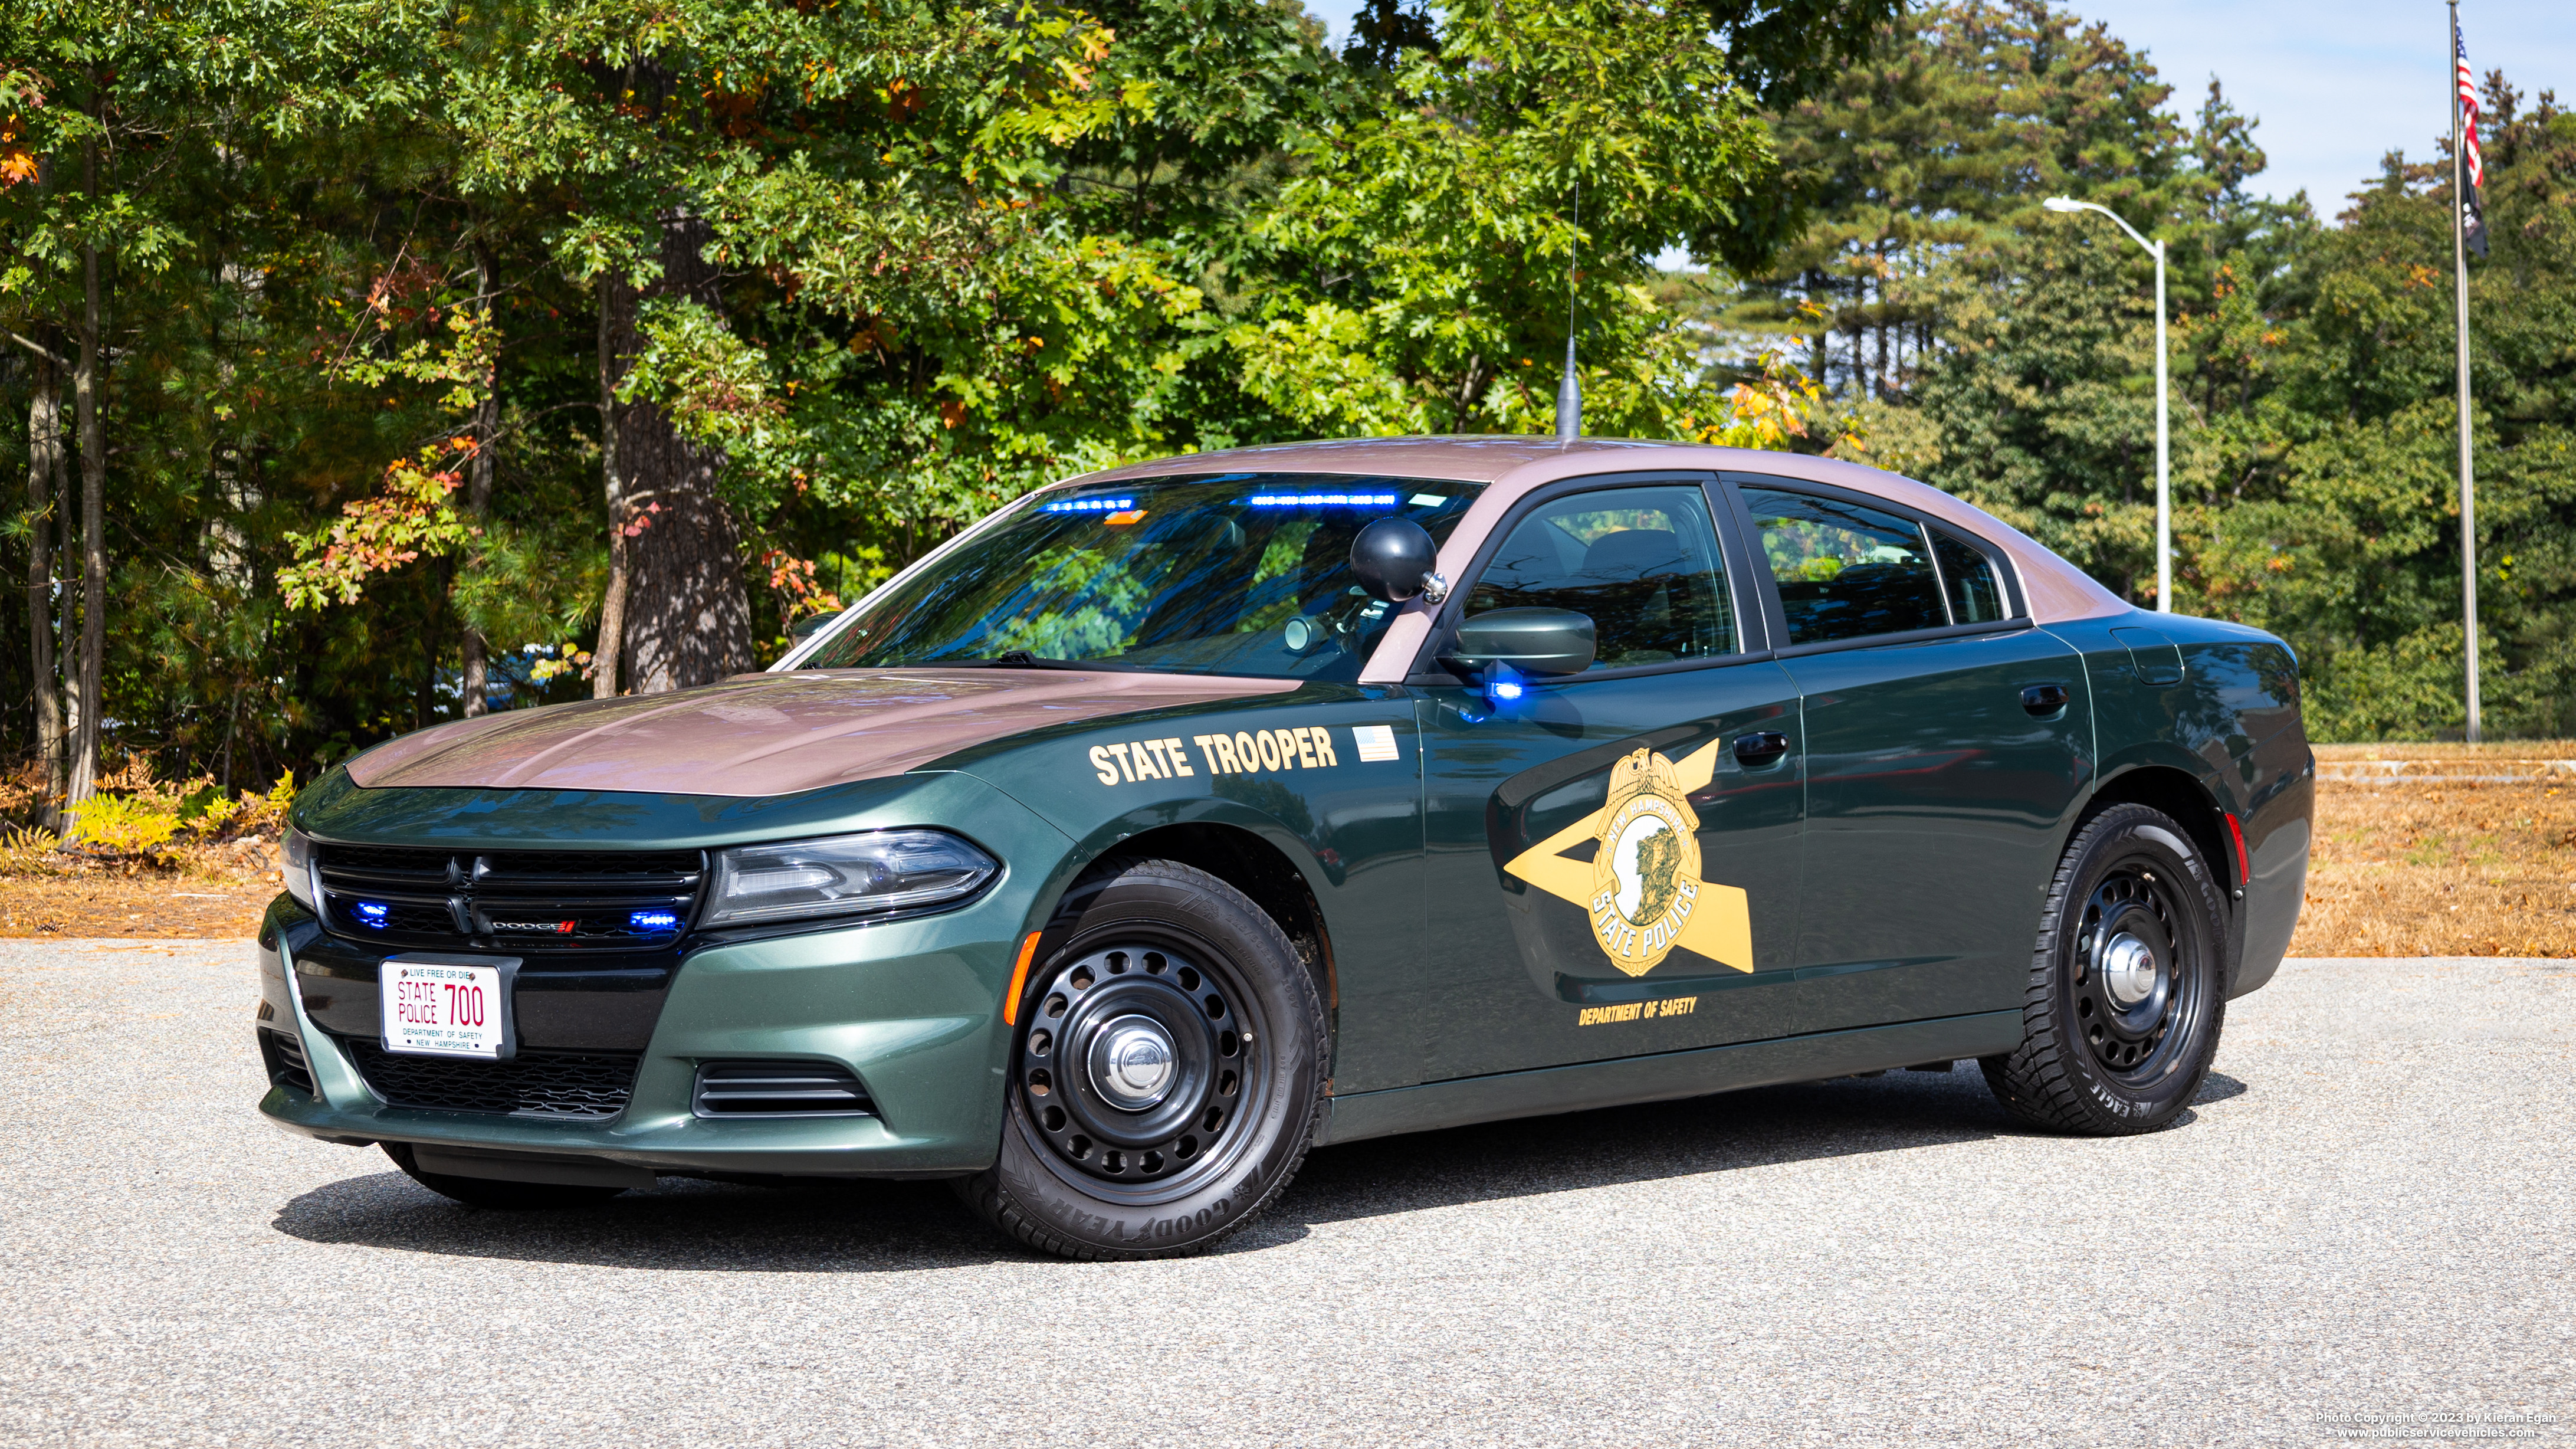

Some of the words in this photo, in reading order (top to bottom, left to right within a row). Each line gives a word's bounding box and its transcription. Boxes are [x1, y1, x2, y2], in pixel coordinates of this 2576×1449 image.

[1089, 737, 1194, 786] STATE
[1193, 726, 1338, 775] TROOPER
[1608, 811, 1627, 842] NEW
[1630, 799, 1685, 837] HAMPSHIRE
[1593, 890, 1637, 958] STATE
[1643, 880, 1698, 956] POLICE
[409, 969, 425, 977] LIVE
[427, 969, 444, 978] FREE
[447, 971, 457, 979] OR
[459, 971, 470, 979] DIE
[398, 981, 436, 1002] STATE
[445, 984, 484, 1027] 700
[399, 1004, 437, 1024] POLICE
[1579, 1002, 1643, 1026] DEPARTMENT
[1643, 1001, 1658, 1019] OF
[1659, 996, 1697, 1017] SAFETY
[403, 1028, 443, 1037] DEPARTMENT
[435, 1040, 470, 1049] HAMPSHIRE
[2089, 1081, 2130, 1118] EAGLE
